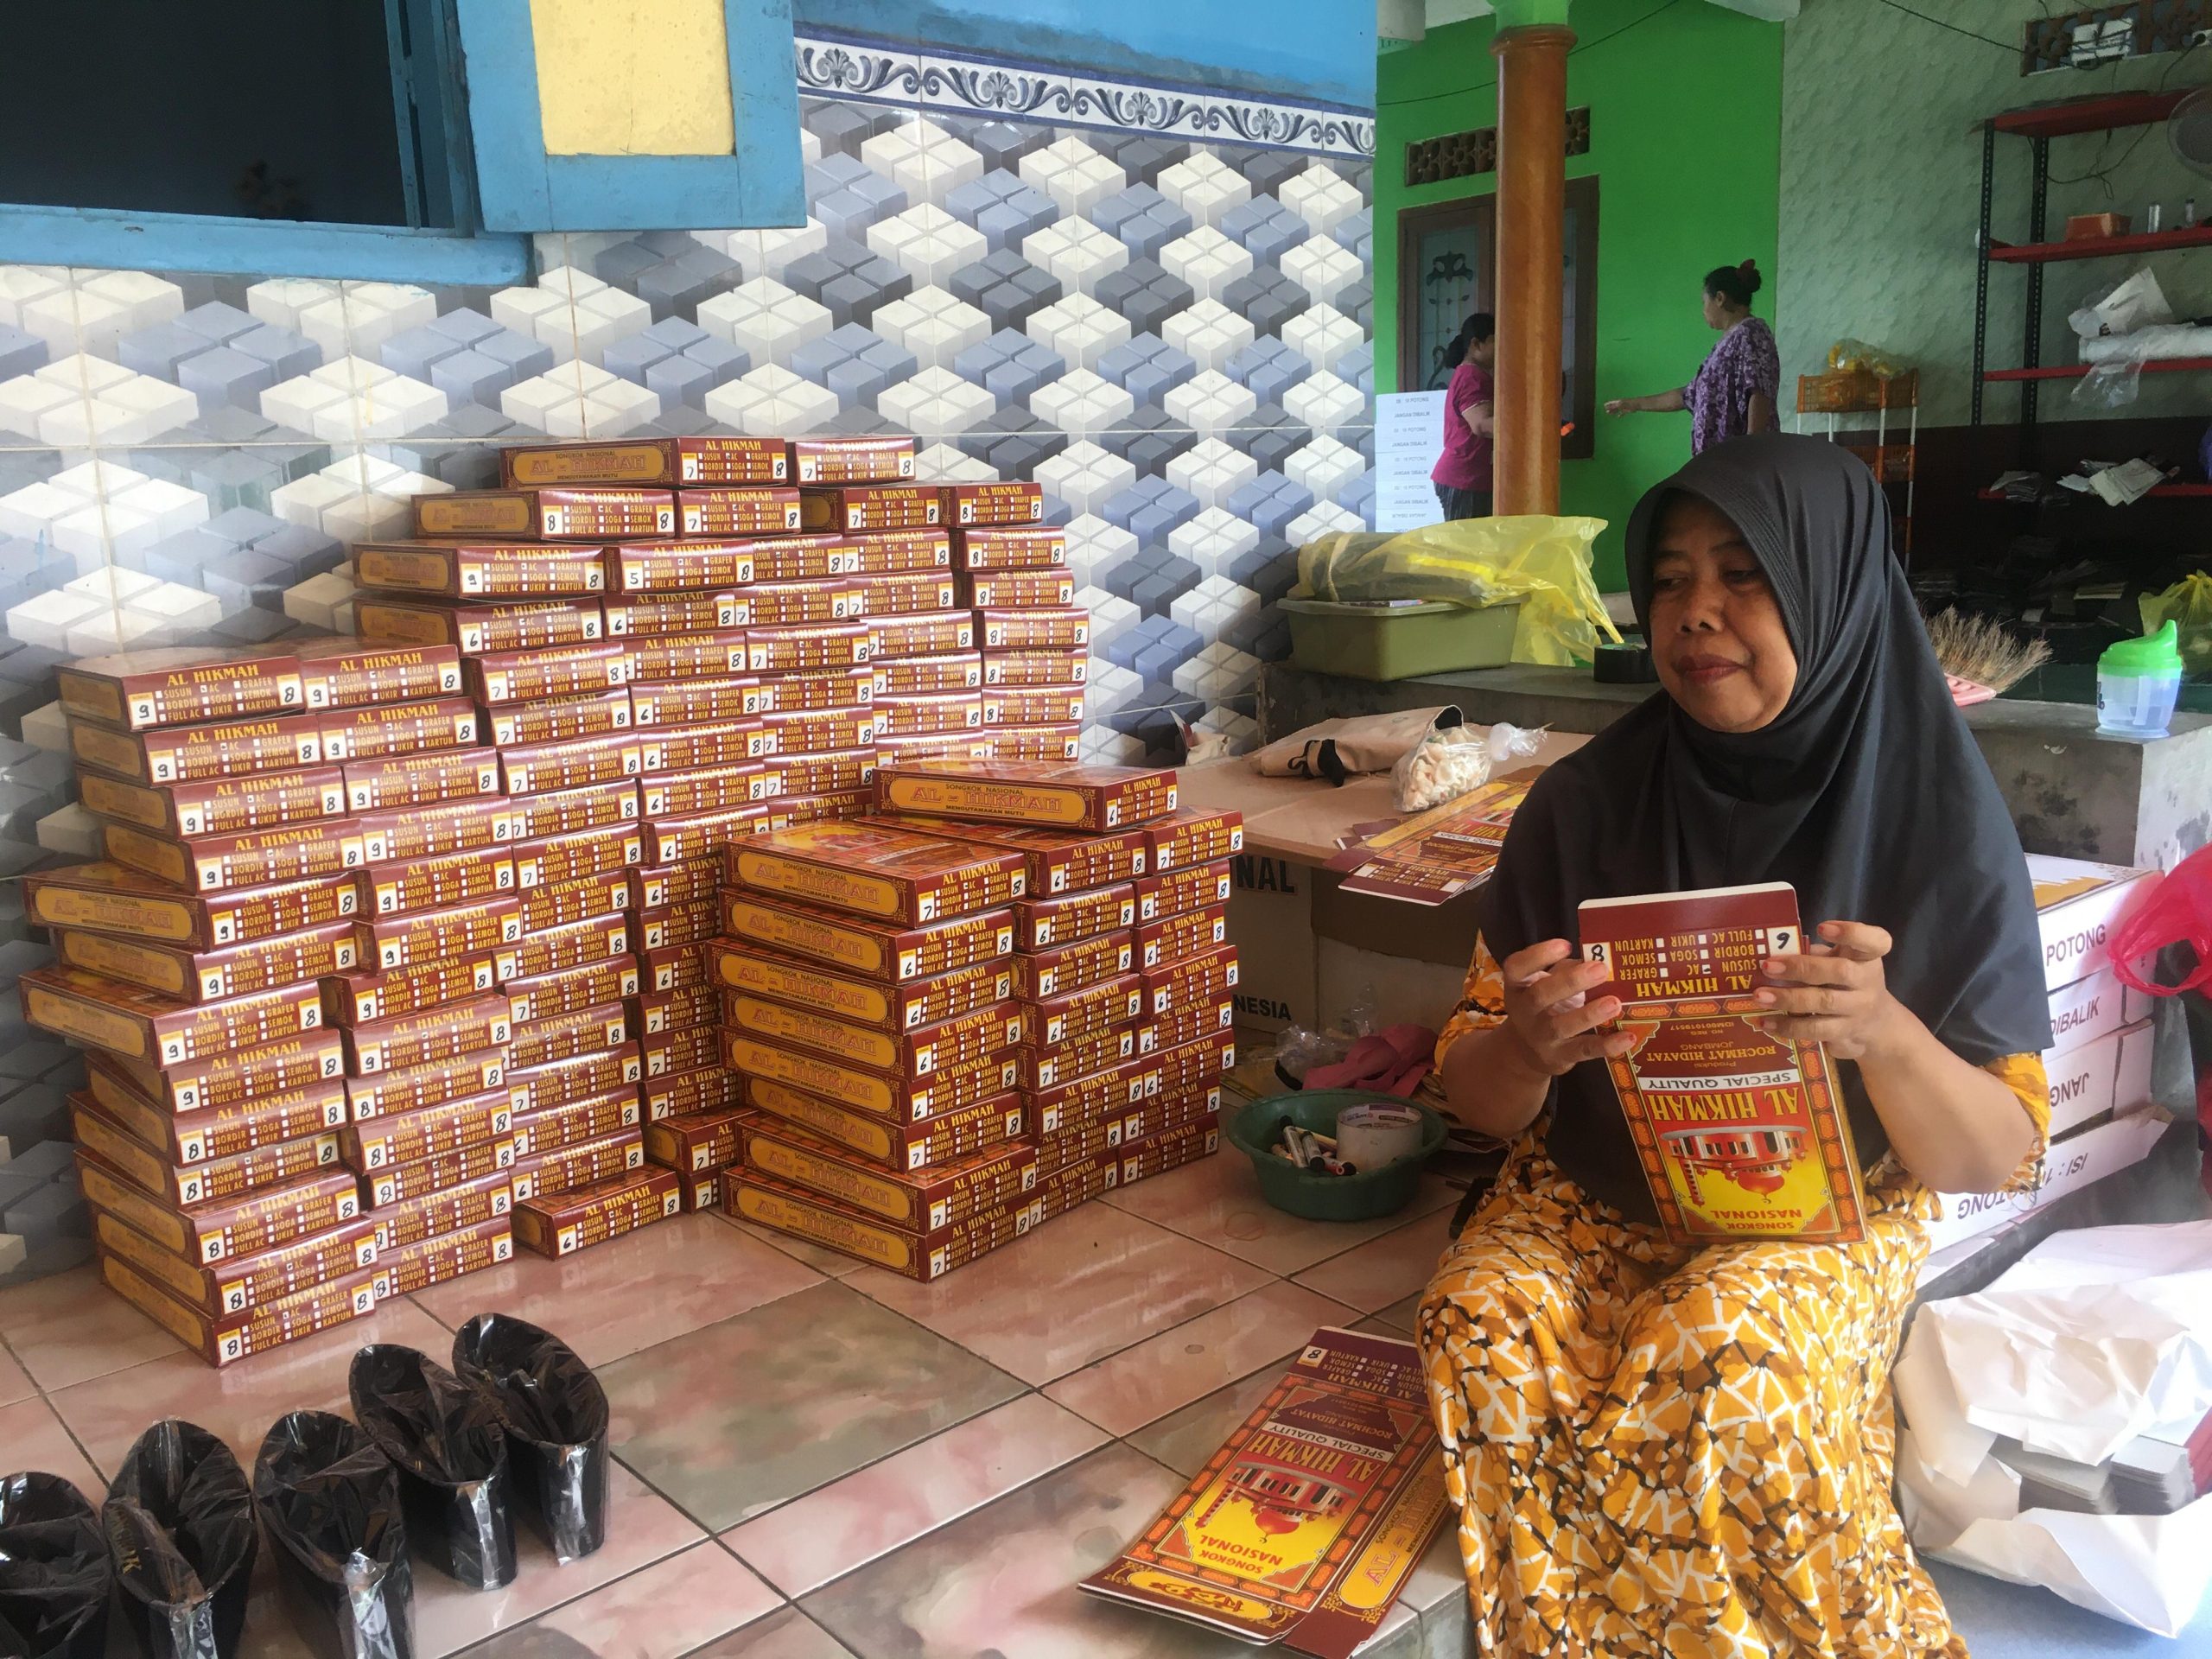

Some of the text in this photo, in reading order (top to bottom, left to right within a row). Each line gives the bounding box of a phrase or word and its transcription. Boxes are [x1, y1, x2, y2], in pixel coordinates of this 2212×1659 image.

[706, 441, 761, 450] AL HIKMAH
[776, 462, 784, 476] 8
[167, 665, 258, 686] AL HIKMAH
[209, 683, 219, 692] AC
[242, 677, 273, 688] GRAFER
[164, 688, 191, 698] SUSUN
[211, 694, 233, 703] SOGA
[244, 689, 271, 699] SEMOK
[284, 687, 295, 702] 8
[166, 699, 198, 710] BORDIR
[213, 705, 232, 715] UKIR
[245, 699, 276, 710] KARTUN
[139, 705, 149, 718] 9
[168, 709, 200, 721] FULL AC
[946, 784, 982, 792] SONGKOK
[911, 786, 941, 803] AL
[964, 791, 1061, 813] HIKMAH
[946, 805, 1002, 815] MENGUTAMAKAN
[1436, 832, 1503, 847] SPECIAL QUALI
[783, 862, 847, 880] SONGKOK NASIONAL
[943, 862, 1001, 885] AL HIKMAH
[755, 863, 780, 881] AL
[798, 873, 879, 904] HIKMAH
[969, 880, 976, 889] AC
[989, 873, 1008, 884] GRAFER
[784, 884, 830, 899] MENGUTAMAKAN
[941, 885, 958, 896] SUSUN
[969, 889, 982, 899] SOGA
[990, 883, 1007, 893] SEMOK
[1013, 880, 1021, 895] 8
[941, 894, 961, 906] BORDIR
[969, 899, 982, 909] UKIR
[990, 893, 1009, 903] KARTUN
[925, 906, 932, 920] 7
[942, 907, 953, 916] FULL
[1671, 935, 1695, 946] UKIR
[1713, 930, 1752, 943] FULL AC
[1615, 938, 1653, 951] KARTUN
[1715, 944, 1755, 957] BORDIR
[2046, 924, 2106, 967] POTONG
[1592, 944, 1605, 962] 8
[1622, 953, 1656, 965] SEMOK
[1670, 950, 1697, 962] SOGA
[1688, 965, 1699, 976] AC
[1722, 959, 1757, 971] SUSUN
[1620, 968, 1657, 980] GRAFER
[1636, 975, 1752, 997] AL HIKMAH
[2050, 996, 2100, 1036] DIBALIK
[1680, 1041, 1733, 1050] JOMBANG
[1646, 1046, 1777, 1061] ROCHMAT HIDAYAT
[1649, 1073, 1790, 1089] SPECIAL QUALITY
[1648, 1088, 1798, 1121] AL HIKMAH
[1711, 1210, 1802, 1218] NASIONAL
[253, 1281, 335, 1319] AL HIKMAH
[321, 1292, 347, 1306] GRAFER
[357, 1294, 366, 1310] 8
[290, 1307, 300, 1317] AC
[322, 1303, 346, 1317] SEMOK
[250, 1317, 275, 1332] SUSUN
[292, 1314, 312, 1327] SOGA
[323, 1312, 351, 1326] KARTUN
[251, 1325, 281, 1342] BORDIR
[293, 1325, 311, 1337] UKIR
[227, 1340, 238, 1355] 8
[252, 1335, 282, 1351] FULL AC
[1307, 1350, 1321, 1358] 8
[1329, 1351, 1359, 1362] KARTUN
[1330, 1357, 1356, 1368] SEMOK
[1371, 1359, 1390, 1369] UKIR
[1322, 1364, 1351, 1376] GRAFER
[1365, 1366, 1386, 1376] SOGA
[1397, 1373, 1425, 1383] ORDIR
[1327, 1373, 1416, 1399] AL HIKMAH
[1397, 1382, 1422, 1392] SUSUN
[1290, 1409, 1393, 1439] ROCHMAT HIDAYAT
[1270, 1425, 1385, 1459] SPECIAL QUALITY
[1247, 1433, 1381, 1482] AL HIKMAH
[1376, 1509, 1402, 1544] SONGKOK
[1198, 1535, 1283, 1566] NASIONAL
[1199, 1550, 1264, 1573] SONGKOK
[1364, 1551, 1398, 1586] AL
